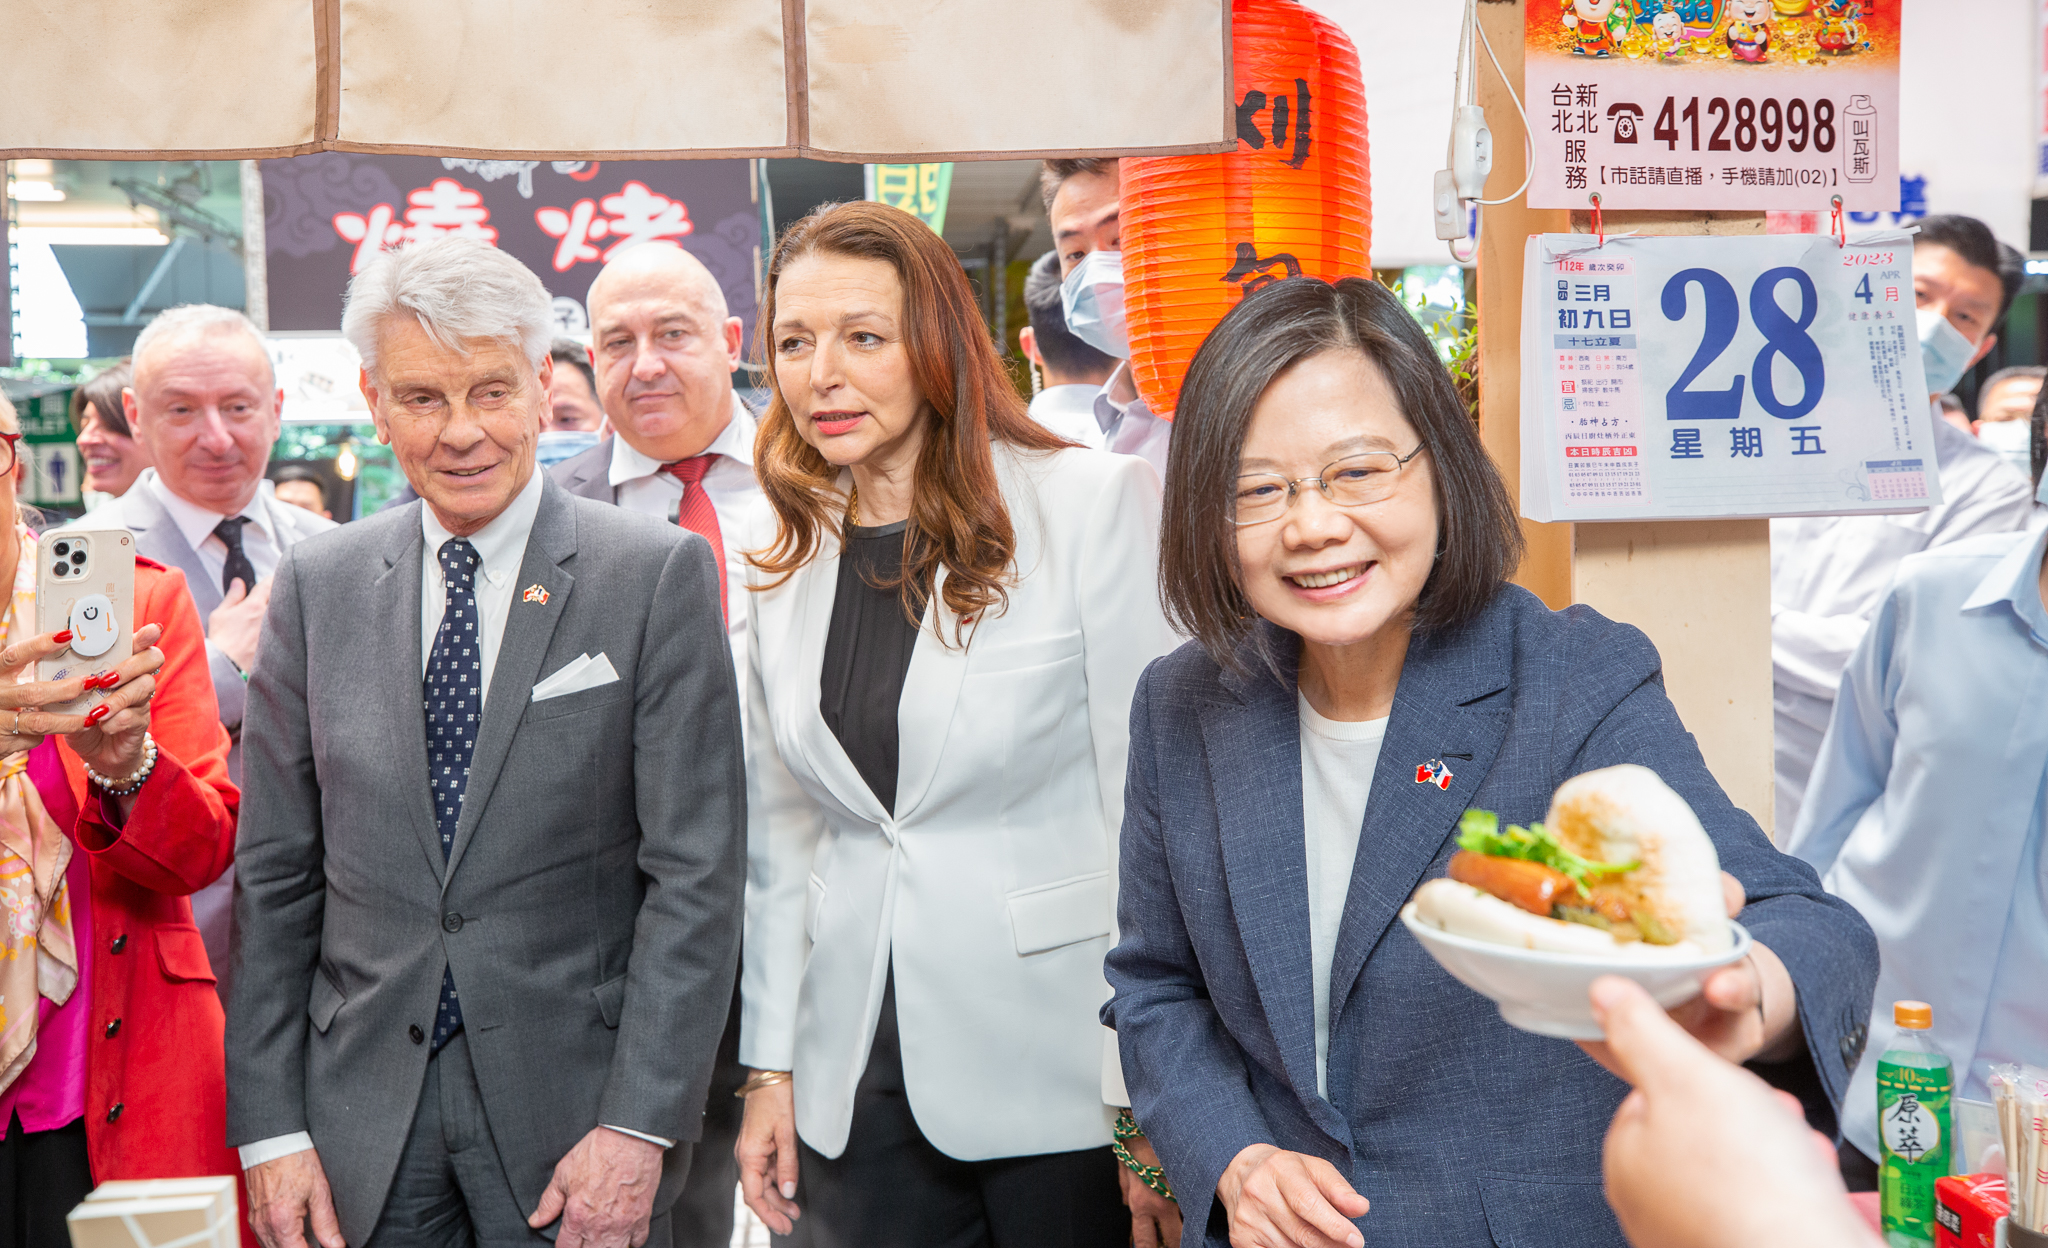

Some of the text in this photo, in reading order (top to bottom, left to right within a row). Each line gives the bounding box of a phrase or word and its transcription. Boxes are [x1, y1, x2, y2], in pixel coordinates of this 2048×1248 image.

[1653, 95, 1836, 153] 4128998
[1852, 120, 1870, 175] 叫瓦斯
[1564, 139, 1587, 189] 服務
[1558, 260, 1585, 271] 112年
[1842, 251, 1894, 267] 2023
[1879, 270, 1901, 280] APR
[1575, 284, 1610, 302] 三月
[1558, 308, 1632, 329] 初九日
[1568, 336, 1622, 347] 十七立夏
[1660, 266, 1825, 420] 28
[1669, 425, 1827, 459] 星期五
[1888, 1092, 1924, 1164] 原萃
